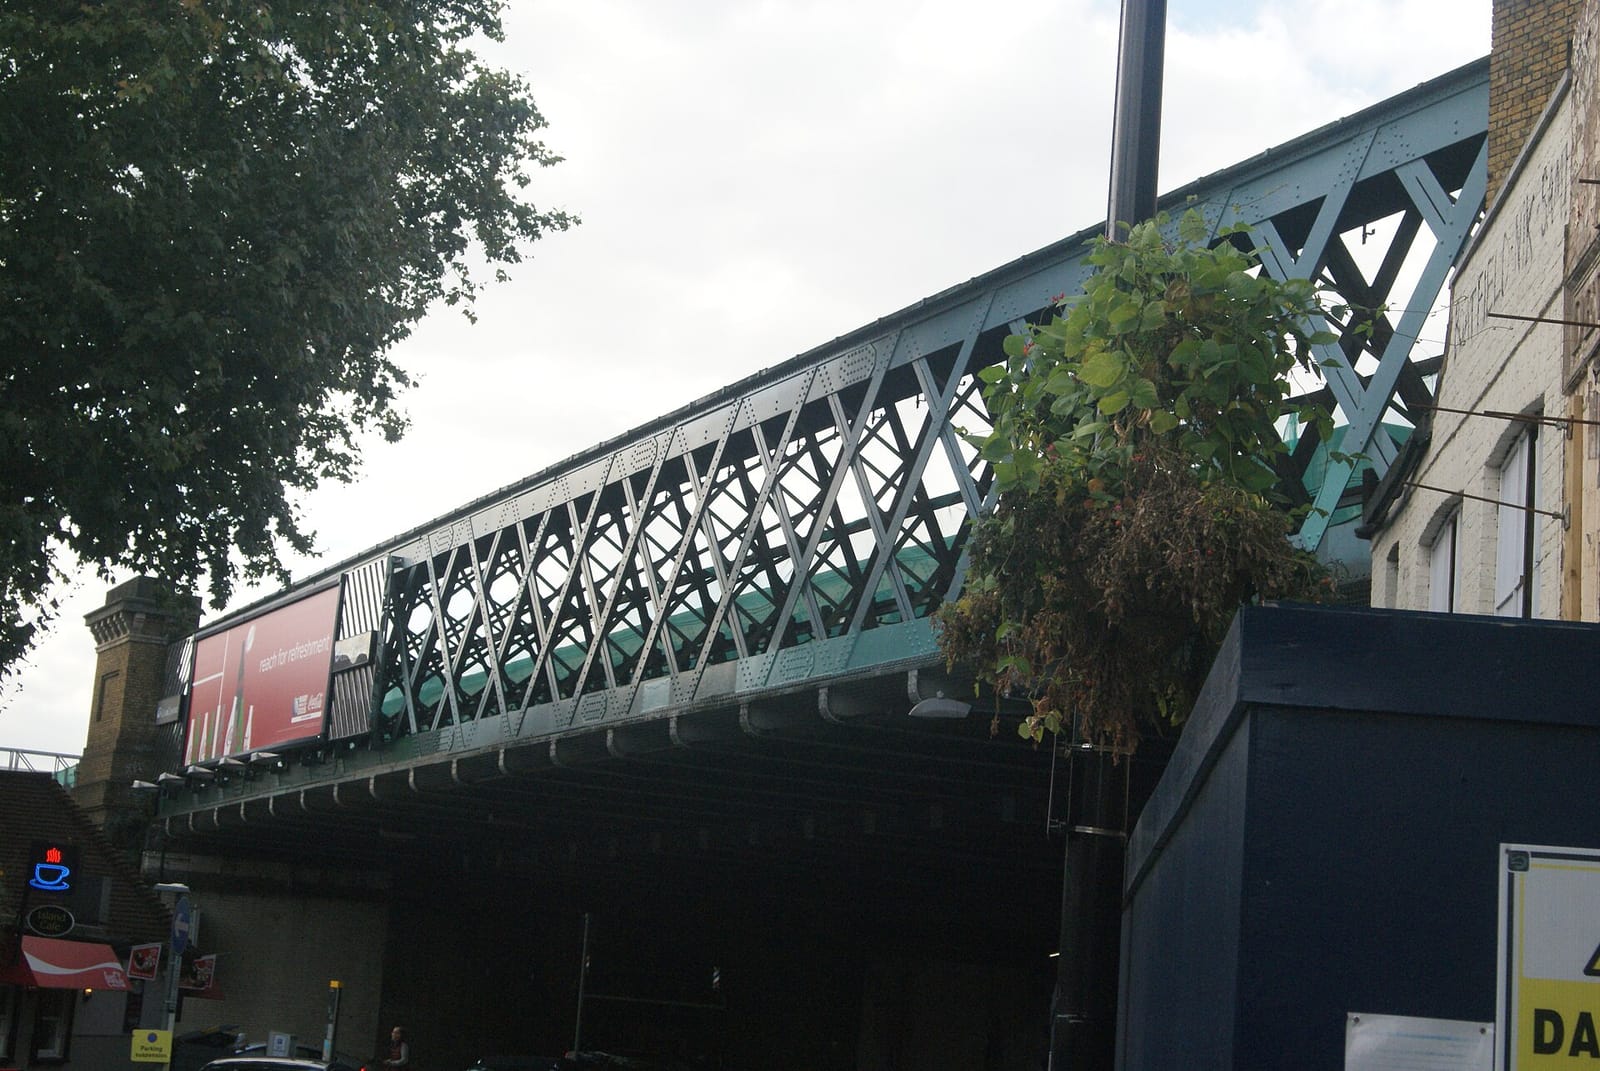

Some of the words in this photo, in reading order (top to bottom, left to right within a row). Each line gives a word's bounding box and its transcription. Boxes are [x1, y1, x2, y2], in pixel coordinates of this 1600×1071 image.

[259, 652, 277, 673] reach
[278, 648, 289, 665] for
[288, 635, 330, 662] refreshment
[1533, 1008, 1600, 1059] DA
